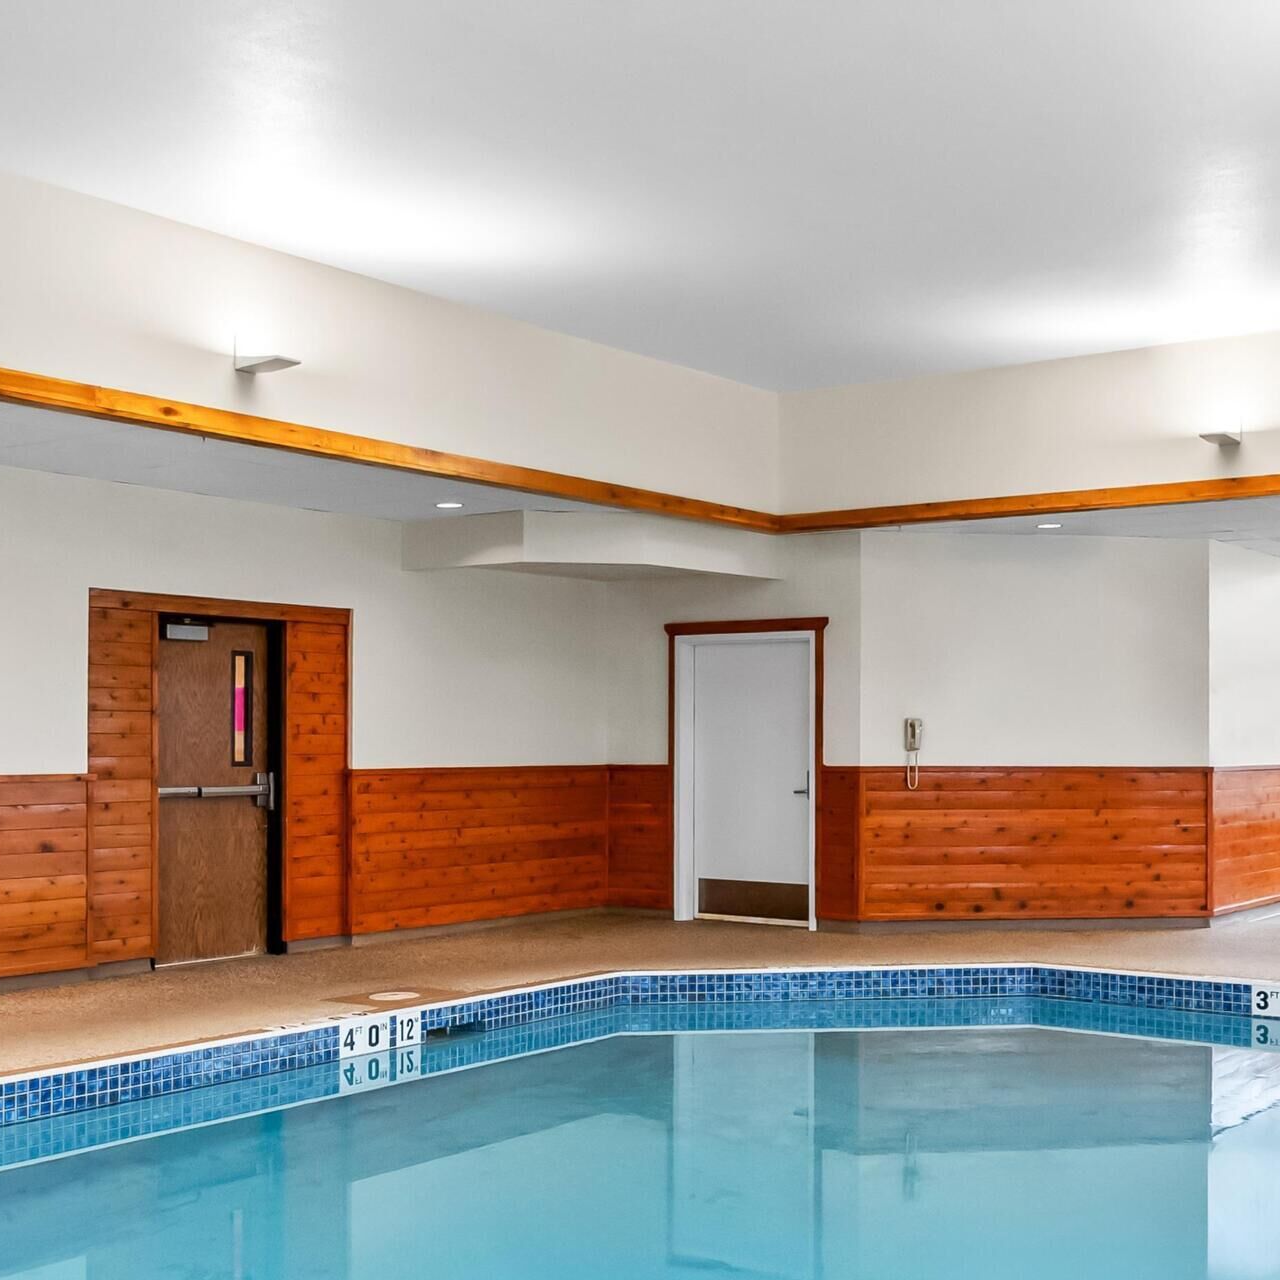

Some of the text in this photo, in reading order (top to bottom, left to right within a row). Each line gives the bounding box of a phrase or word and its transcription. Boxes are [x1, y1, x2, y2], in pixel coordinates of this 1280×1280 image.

[1256, 991, 1269, 1010] 3
[1270, 991, 1280, 999] FT
[343, 1027, 355, 1051] 4
[368, 1024, 379, 1047] 0
